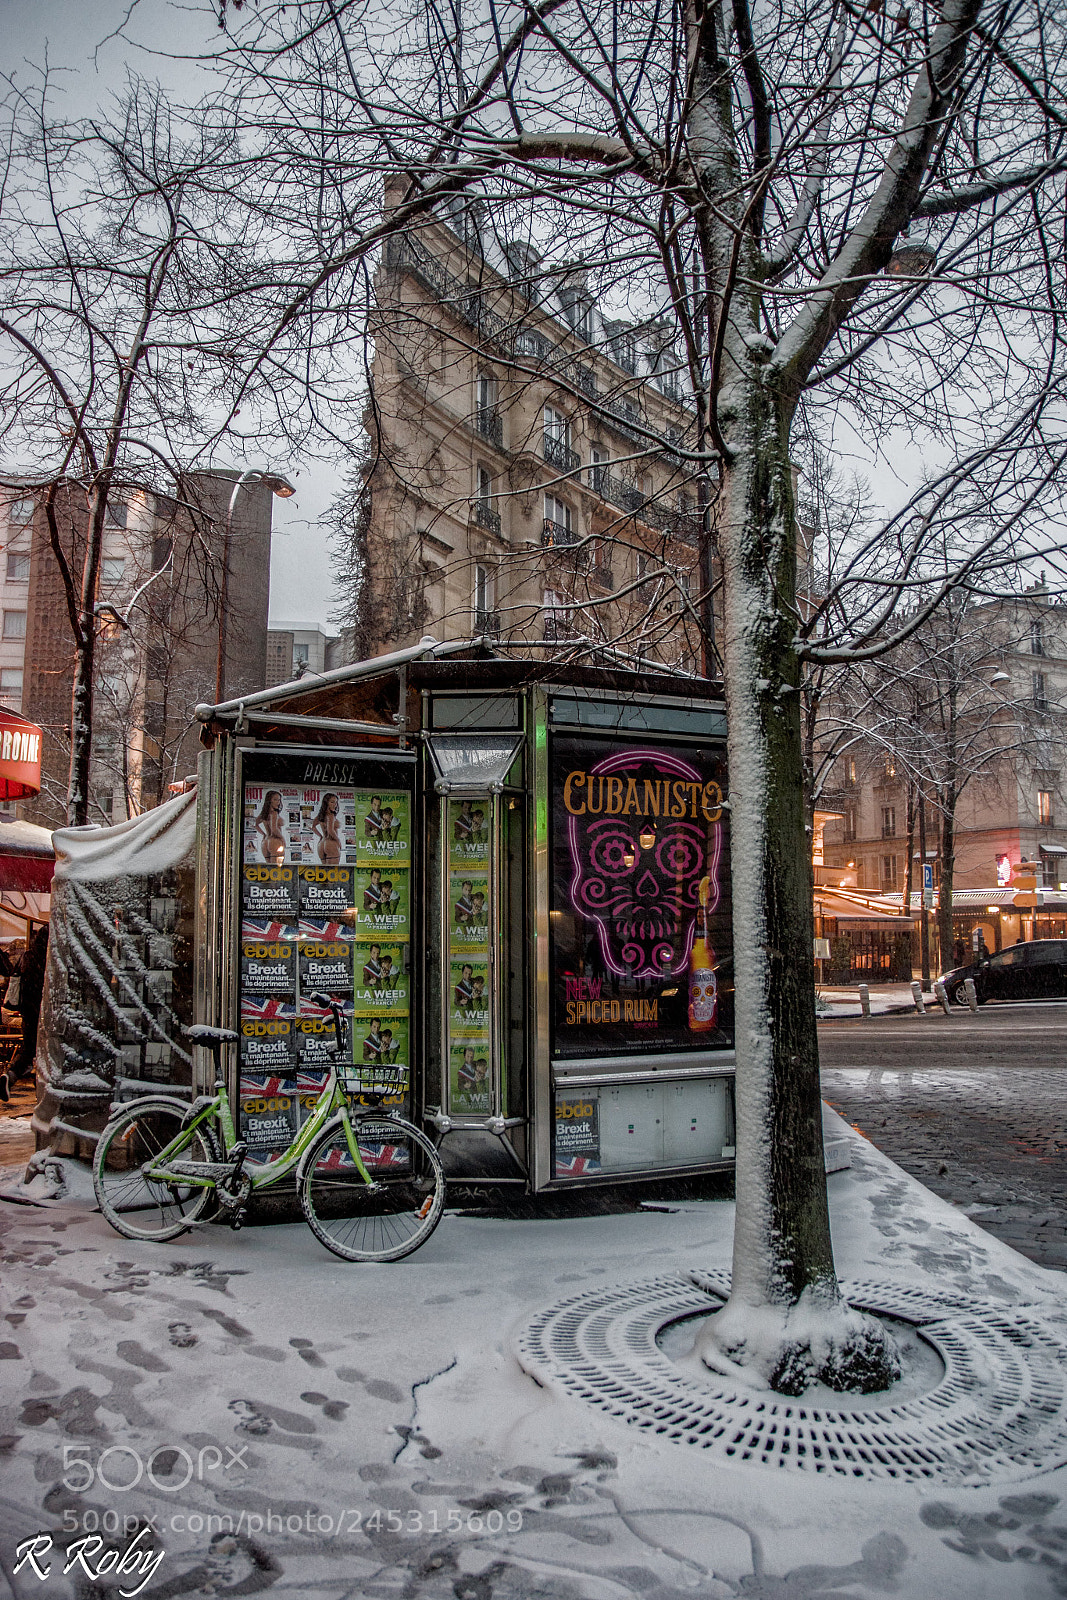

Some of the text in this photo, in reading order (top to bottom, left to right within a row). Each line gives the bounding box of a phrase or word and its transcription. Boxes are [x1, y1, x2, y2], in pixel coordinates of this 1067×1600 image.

[0, 730, 40, 763] RONNE
[303, 762, 357, 784] PRESSE
[245, 788, 263, 800] HOT
[304, 789, 321, 802] HOT
[563, 770, 723, 822] CUBANISTO
[358, 840, 373, 849] LA
[375, 840, 407, 850] WEED
[465, 843, 489, 852] WEE
[246, 865, 292, 881] ebdo
[304, 866, 350, 882] ebdo
[250, 886, 289, 897] Brexit
[308, 887, 345, 898] Brexit
[357, 914, 372, 923] LA
[374, 914, 407, 923] WEED
[465, 926, 489, 935] WEE
[244, 942, 292, 959] ebdo
[304, 942, 350, 958] ebdo
[248, 963, 287, 975] Brexit
[309, 962, 346, 974] Brexit
[357, 989, 372, 999] LA
[374, 989, 407, 999] WEED
[565, 976, 603, 1000] NEW
[465, 1010, 489, 1019] WEE
[566, 998, 658, 1025] SPICED RUM
[242, 1020, 290, 1037] ebdo
[247, 1040, 287, 1053] Brexit
[243, 1097, 292, 1114] ebdo
[555, 1099, 594, 1119] ebdo
[248, 1116, 288, 1131] Brexit
[556, 1121, 591, 1135] Brexit
